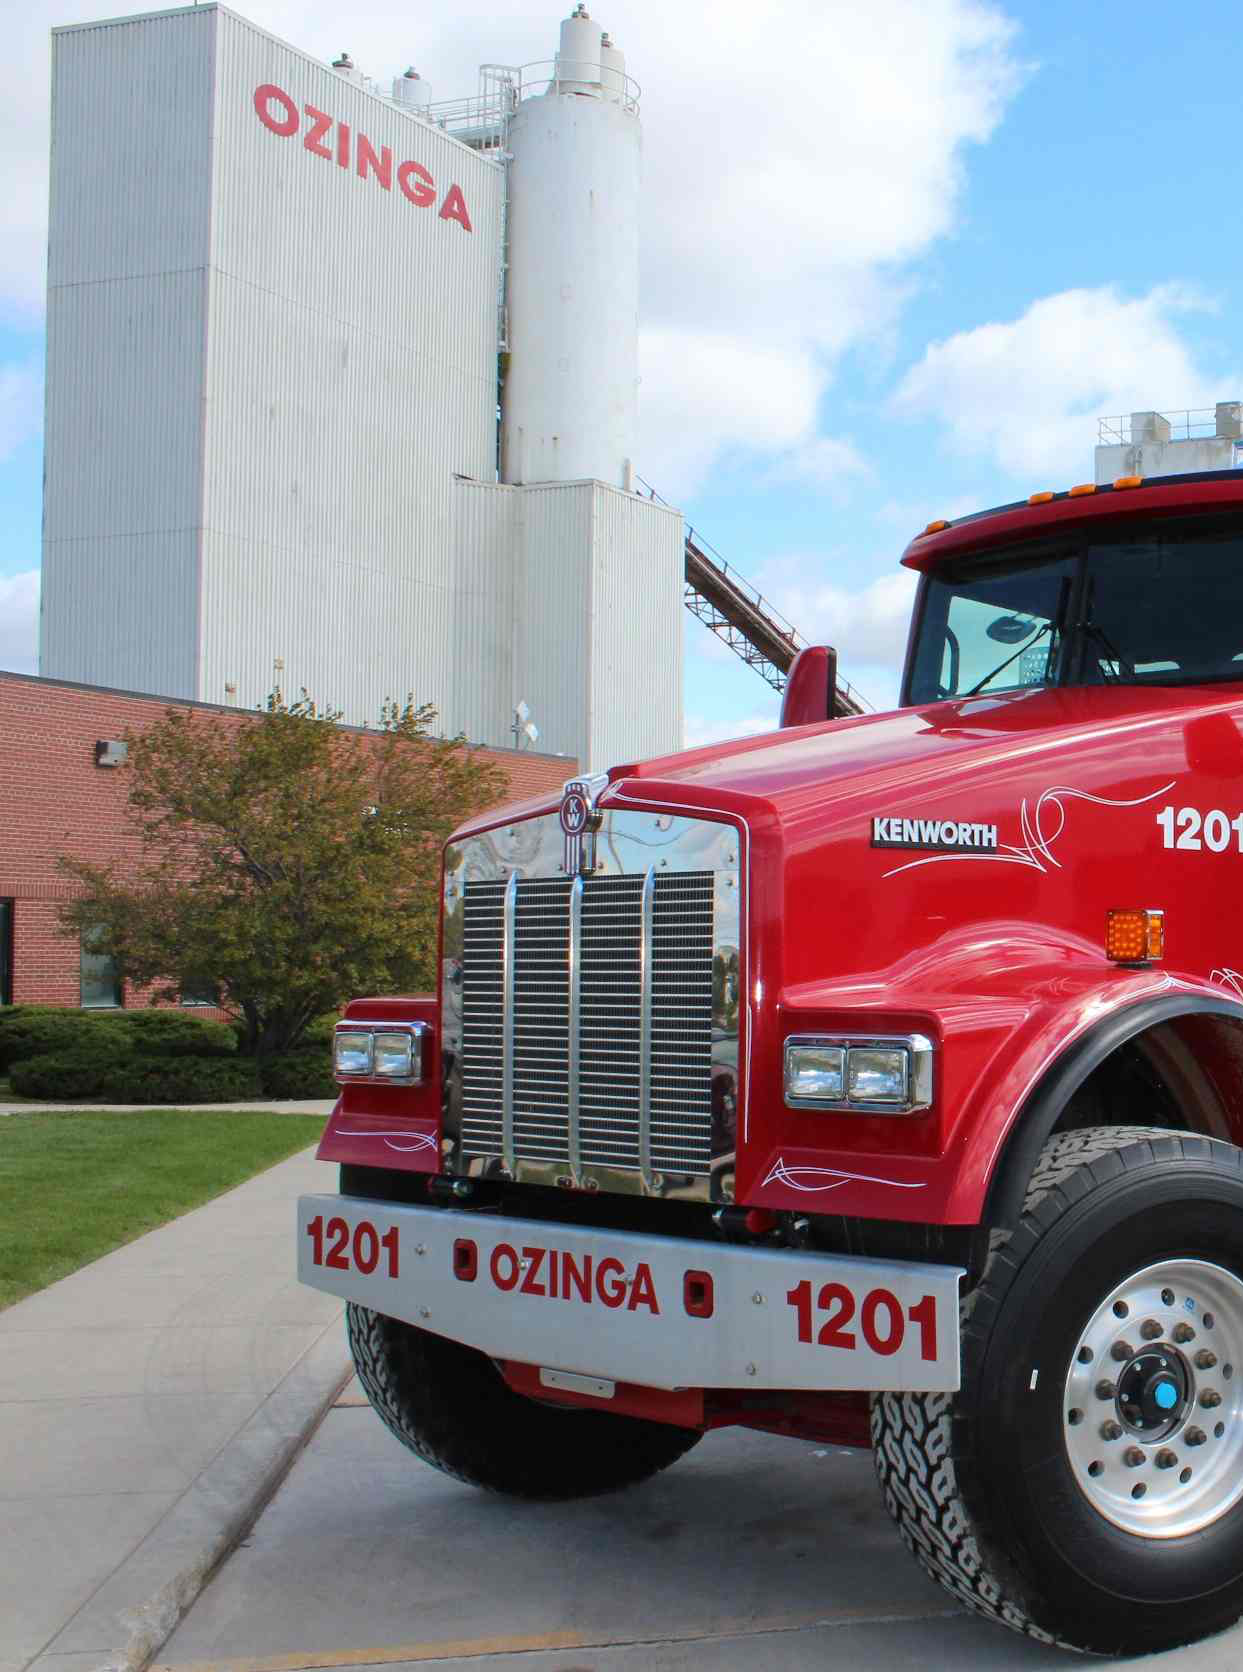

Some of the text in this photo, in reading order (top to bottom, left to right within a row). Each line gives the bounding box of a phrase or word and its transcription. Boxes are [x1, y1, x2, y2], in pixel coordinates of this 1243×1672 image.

[253, 84, 473, 232] OZINGA
[874, 817, 998, 848] KENWORTH
[306, 1215, 399, 1278] 1201
[489, 1242, 660, 1316] OZINGA
[787, 1281, 939, 1362] 1201
